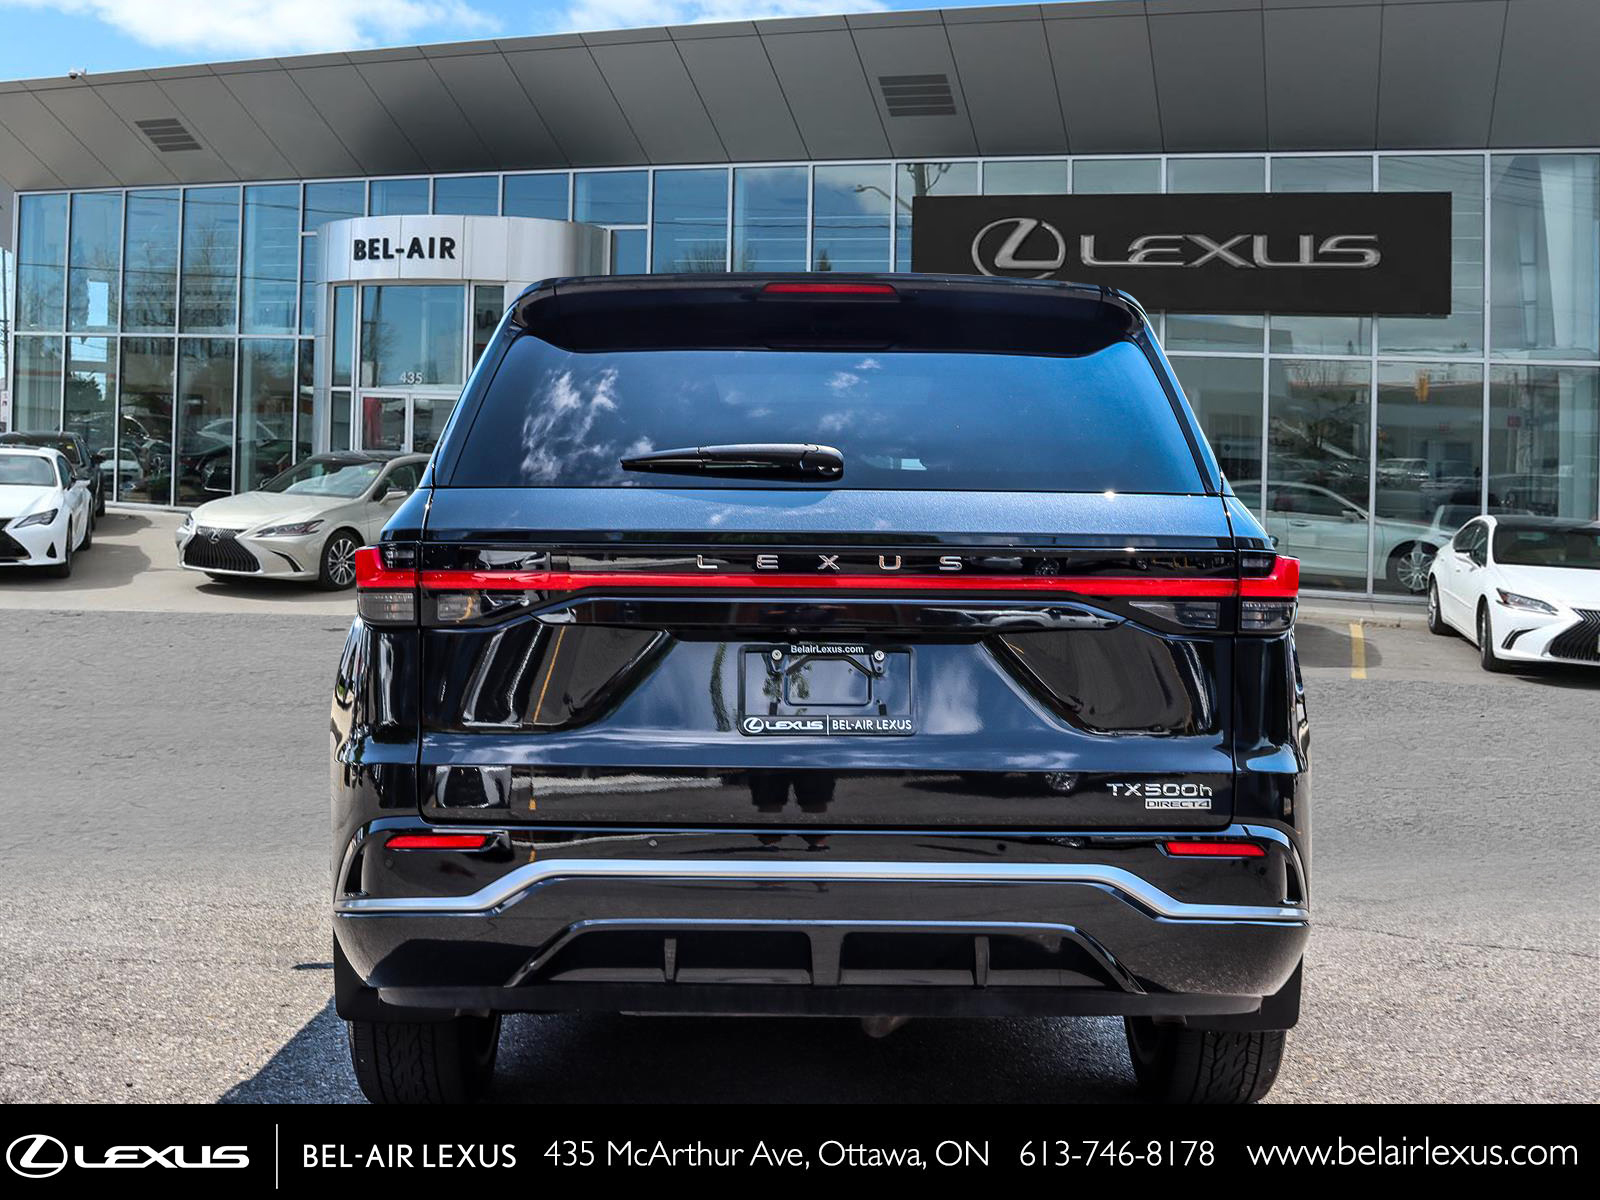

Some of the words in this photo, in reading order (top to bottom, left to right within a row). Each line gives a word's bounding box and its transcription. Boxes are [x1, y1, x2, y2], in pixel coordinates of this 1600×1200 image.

[354, 236, 456, 260] BEL-AIR
[1080, 234, 1381, 268] LEXUS
[399, 371, 424, 384] 435
[696, 555, 963, 570] LEXUS
[790, 644, 864, 655] BelairLexus.com
[765, 721, 824, 730] LEXUS
[832, 720, 874, 731] BEL-AIR
[877, 720, 912, 731] LEXUS
[1147, 800, 1210, 808] DIRECT4
